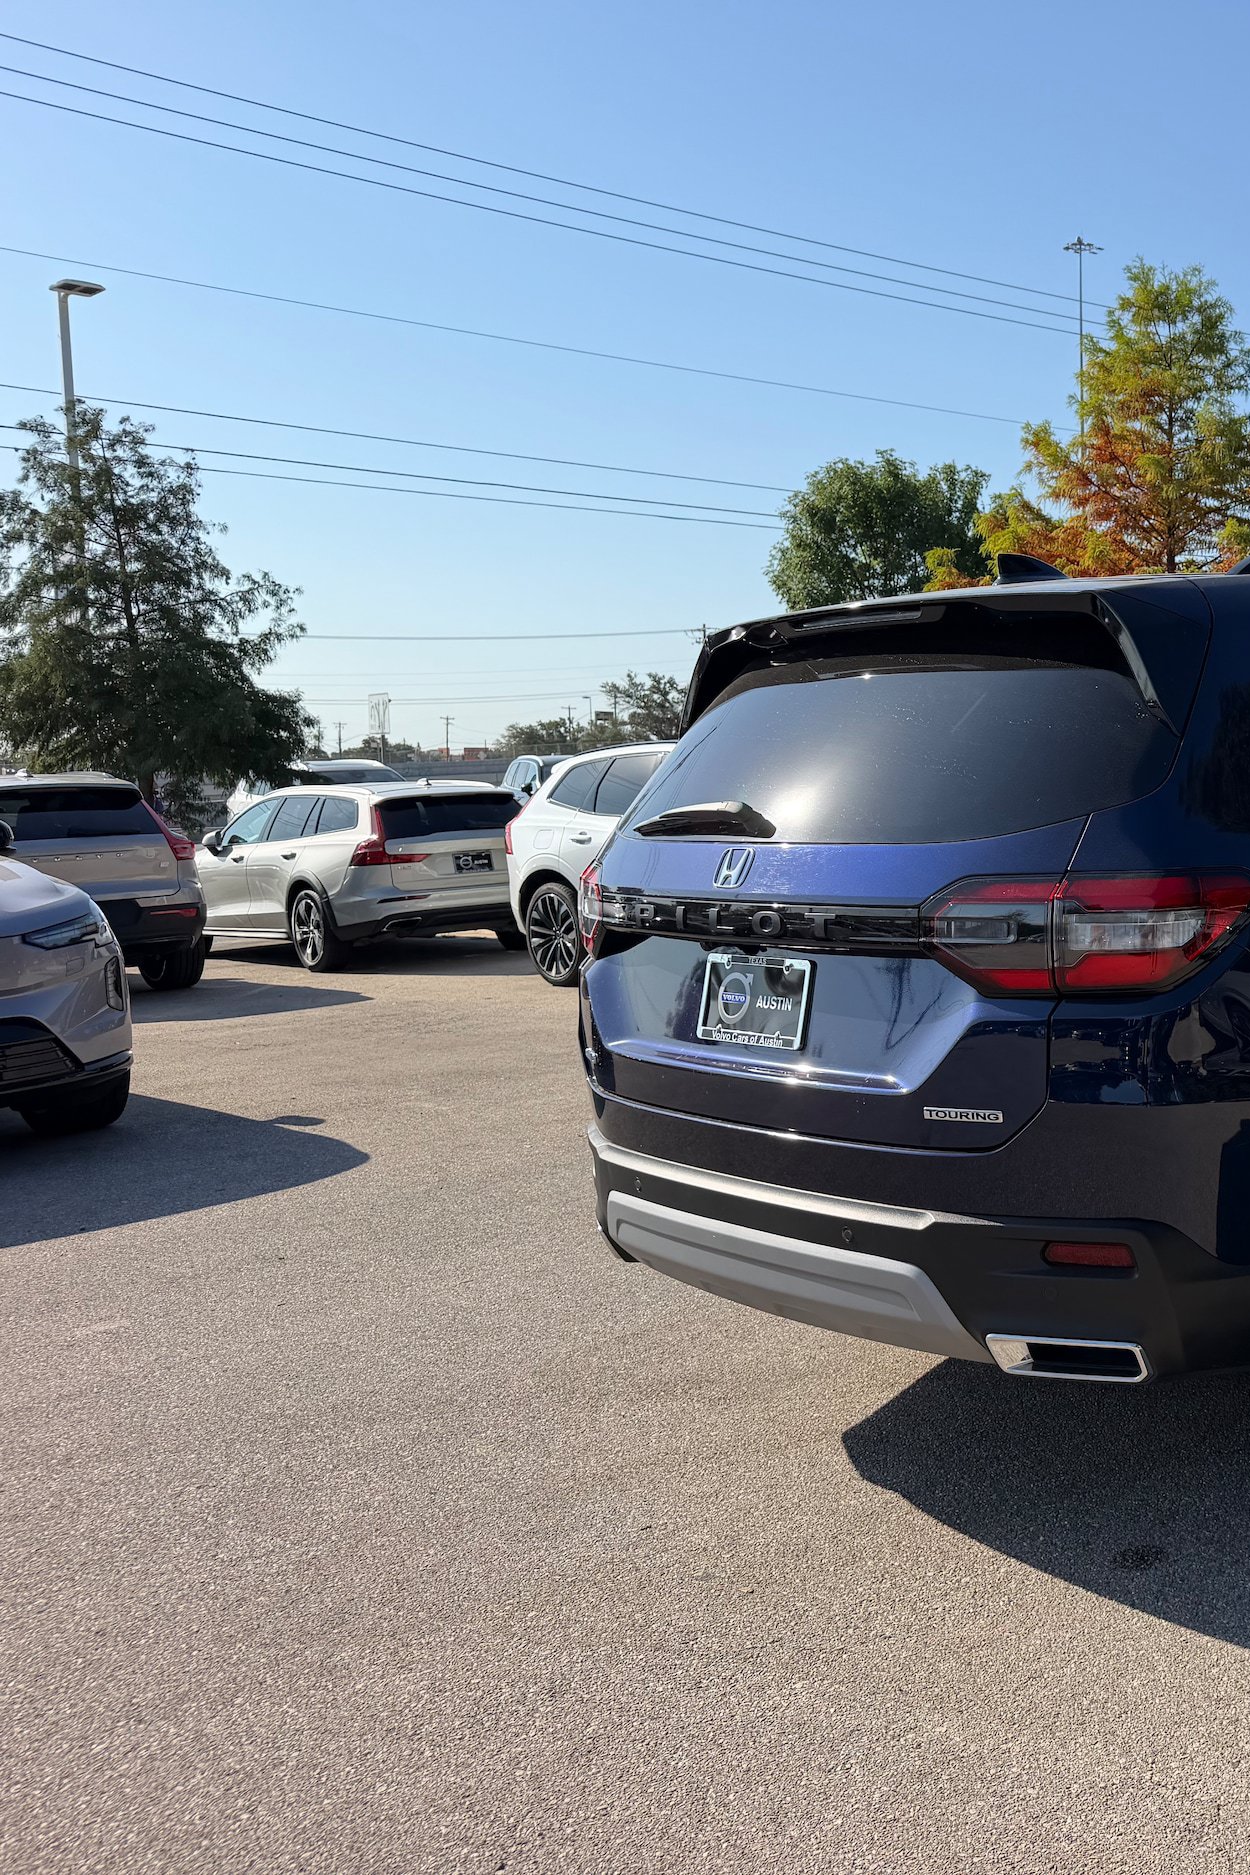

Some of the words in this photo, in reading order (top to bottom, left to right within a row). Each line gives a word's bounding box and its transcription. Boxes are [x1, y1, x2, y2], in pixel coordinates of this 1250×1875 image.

[634, 902, 836, 939] PILOT
[748, 957, 767, 965] TEXAS
[722, 994, 746, 1002] VOLVO
[756, 995, 792, 1011] AUSTIN
[711, 1030, 731, 1041] Volvo
[731, 1032, 749, 1043] Cars
[750, 1035, 758, 1044] of
[759, 1036, 784, 1047] Austin
[926, 1110, 999, 1121] TOURING
